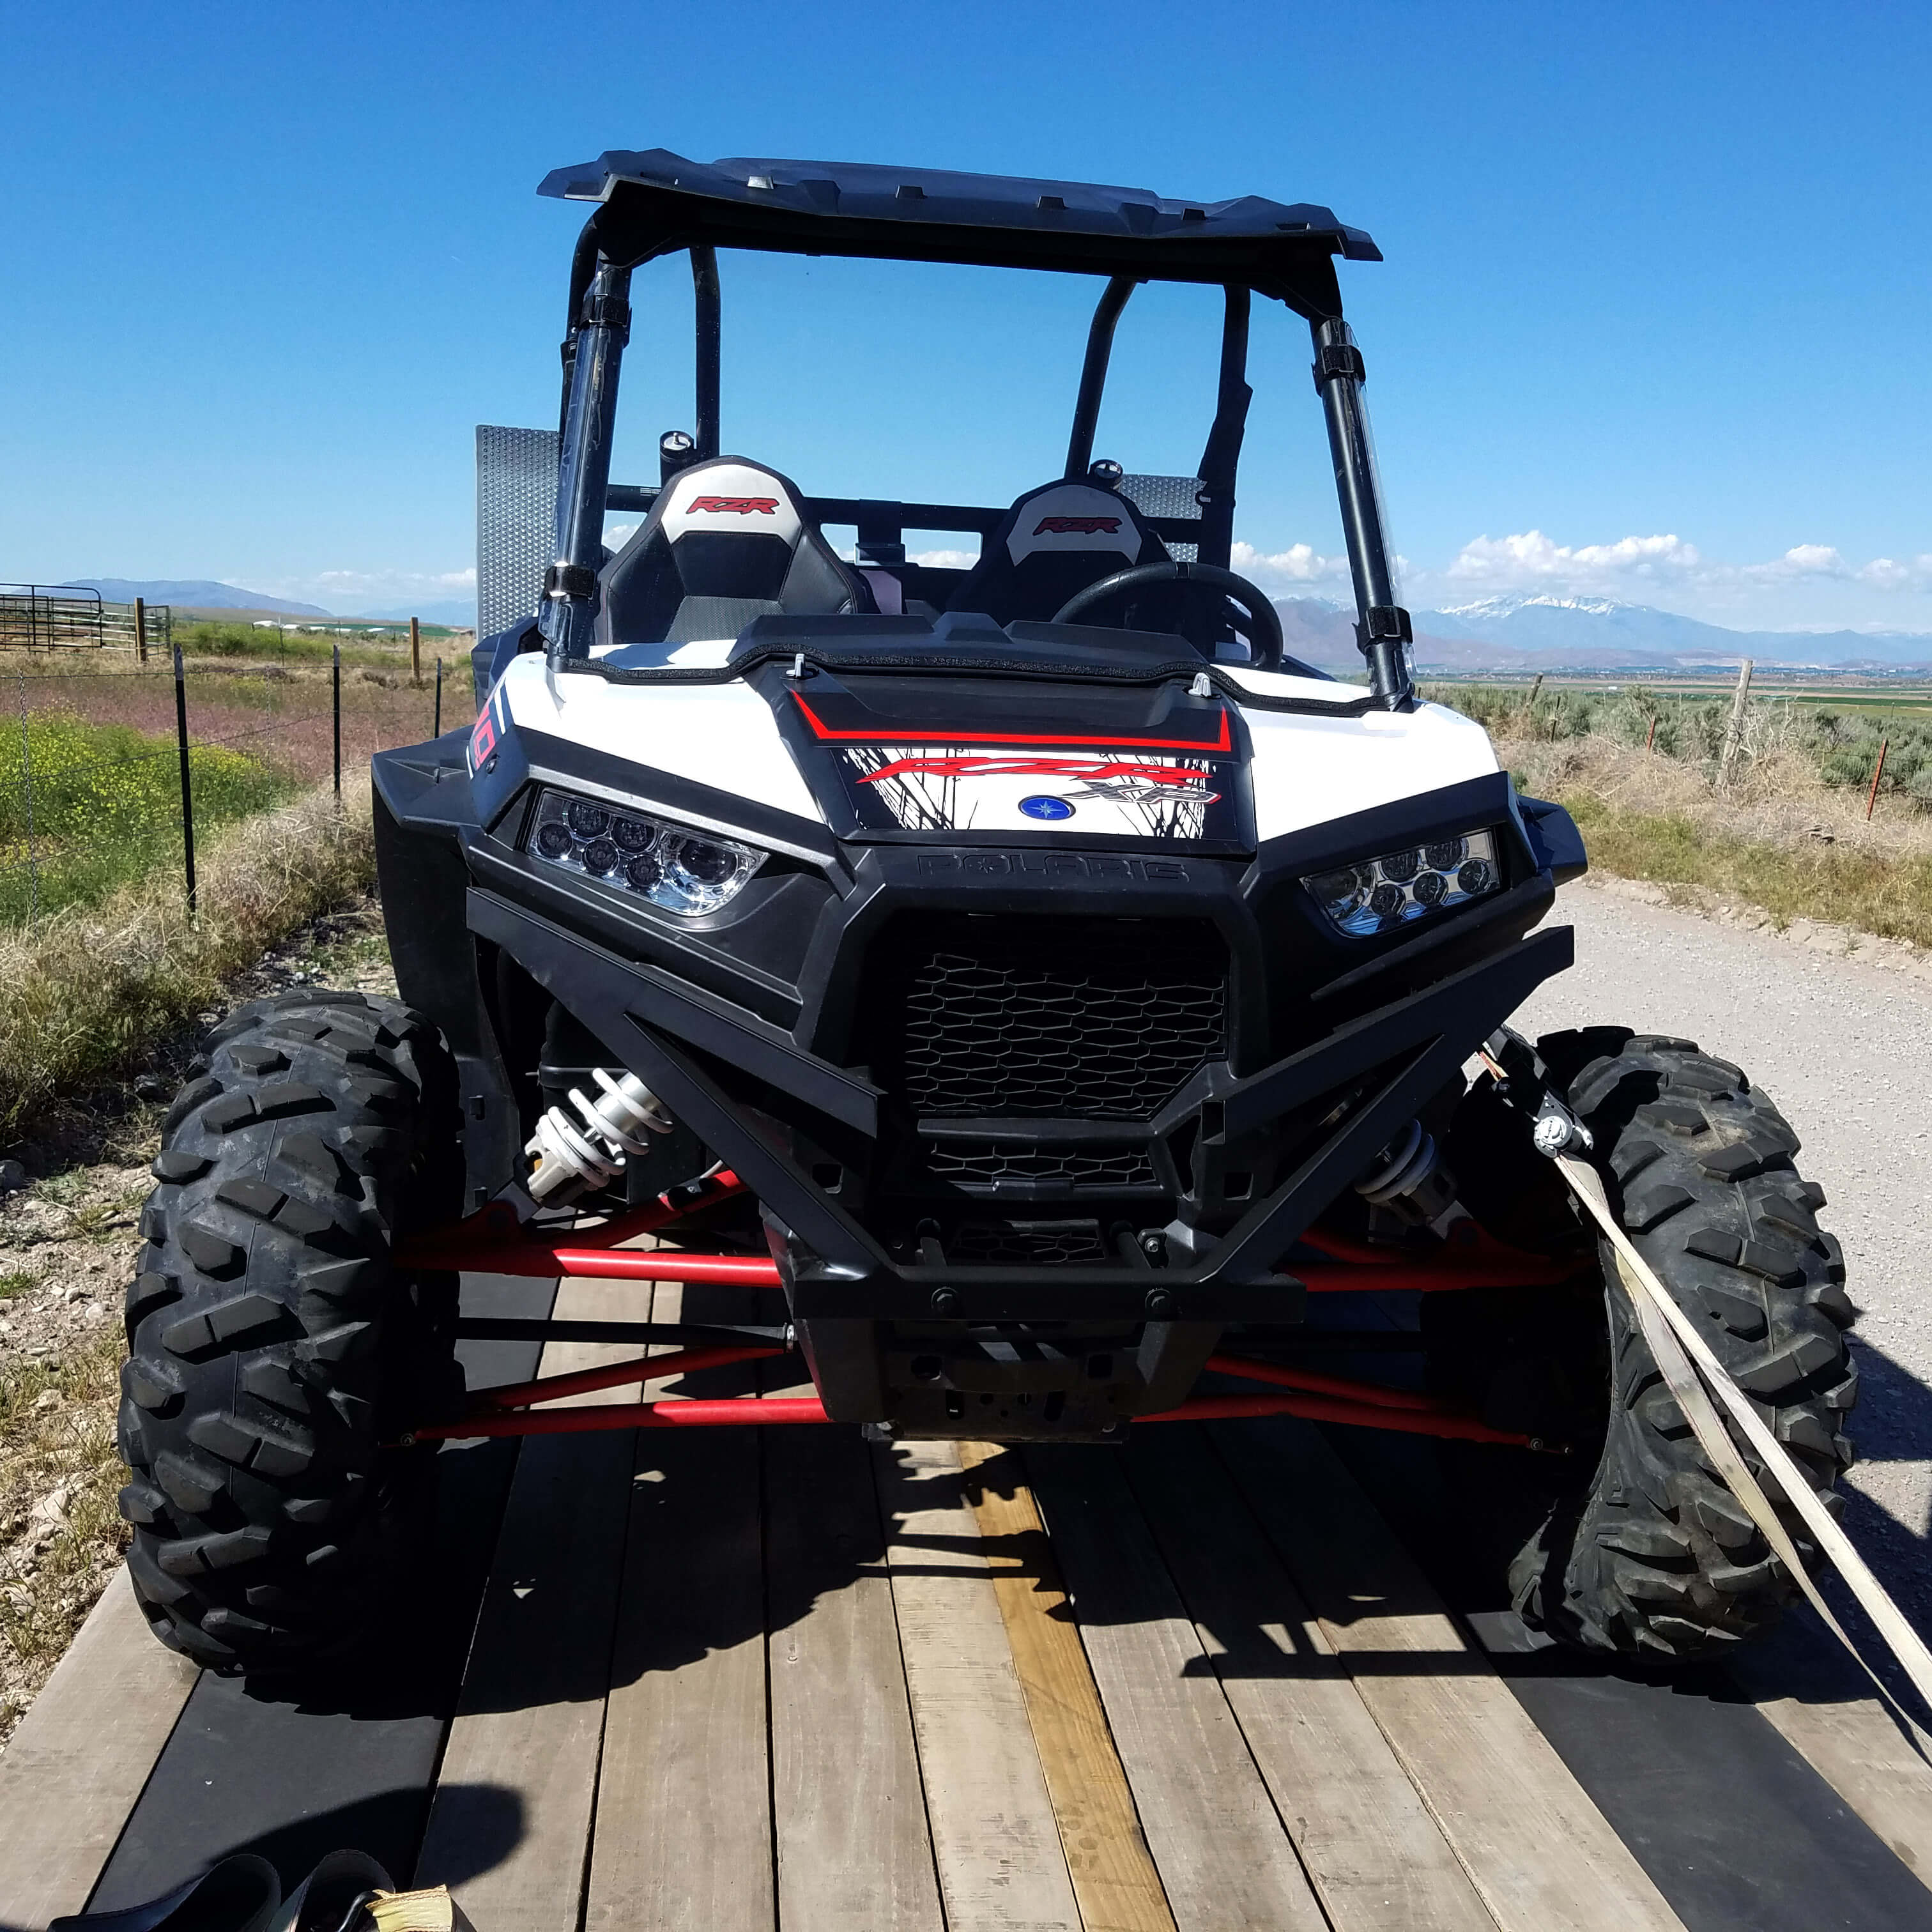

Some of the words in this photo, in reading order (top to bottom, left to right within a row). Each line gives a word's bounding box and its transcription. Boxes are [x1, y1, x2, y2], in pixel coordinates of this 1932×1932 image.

[686, 496, 779, 514] RZR
[1032, 517, 1123, 536] RZR
[855, 757, 1213, 786] RZR
[1056, 781, 1222, 804] XP
[917, 854, 1191, 882] POLARIS
